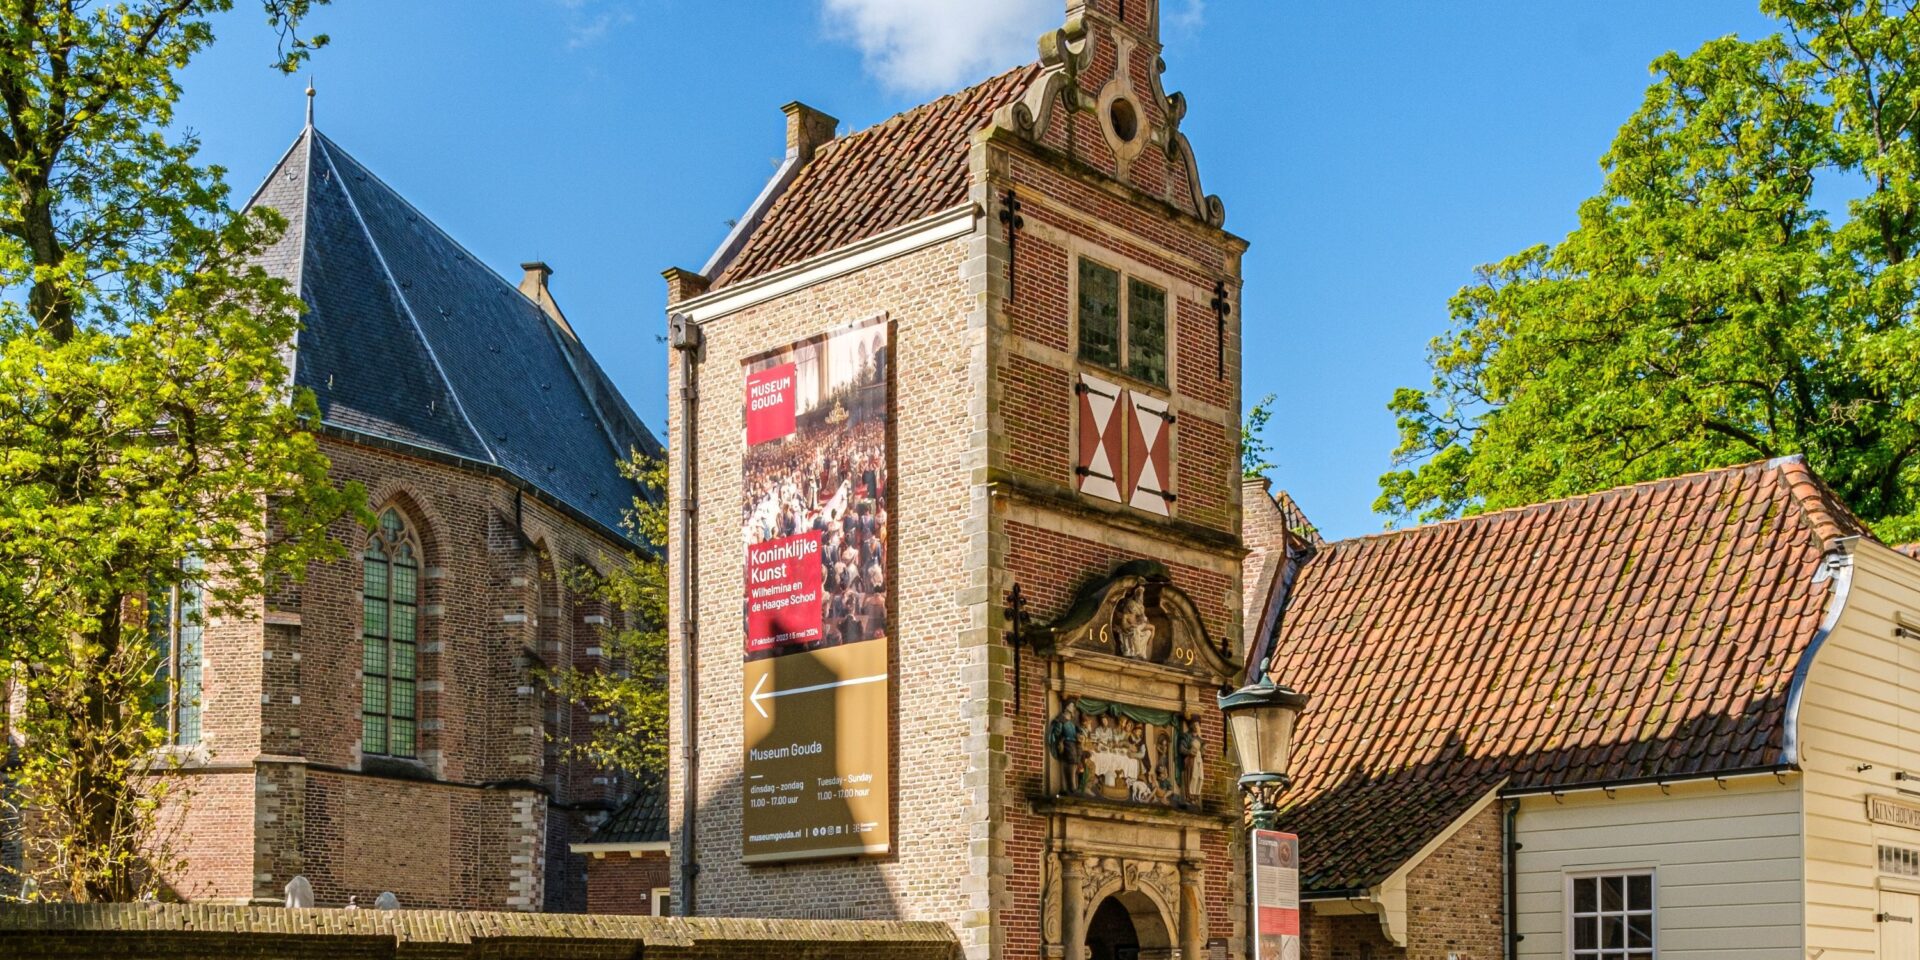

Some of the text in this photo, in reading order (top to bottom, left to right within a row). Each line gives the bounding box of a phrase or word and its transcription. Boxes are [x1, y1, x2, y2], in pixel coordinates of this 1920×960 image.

[751, 376, 791, 398] MUSEUM
[751, 392, 784, 411] GOUDA
[751, 539, 818, 566] Koninklijke
[751, 563, 787, 584] Kunst
[752, 581, 802, 599] Wilhelmina en
[752, 591, 816, 612] de Haagse School
[750, 741, 822, 762] Museum Gouda
[751, 782, 774, 794] dinsdag
[780, 781, 804, 791] zondag
[818, 776, 843, 787] Tuesday
[848, 773, 872, 784] Sunday
[751, 798, 765, 808] 11.00
[771, 796, 787, 806] 17.00
[788, 796, 798, 804] uur
[818, 790, 832, 800] 11.00
[838, 789, 854, 798] 17.00
[854, 788, 870, 797] hour
[1874, 802, 1920, 826] KUNSTHOUWE
[749, 829, 801, 842] museumgouda.nl
